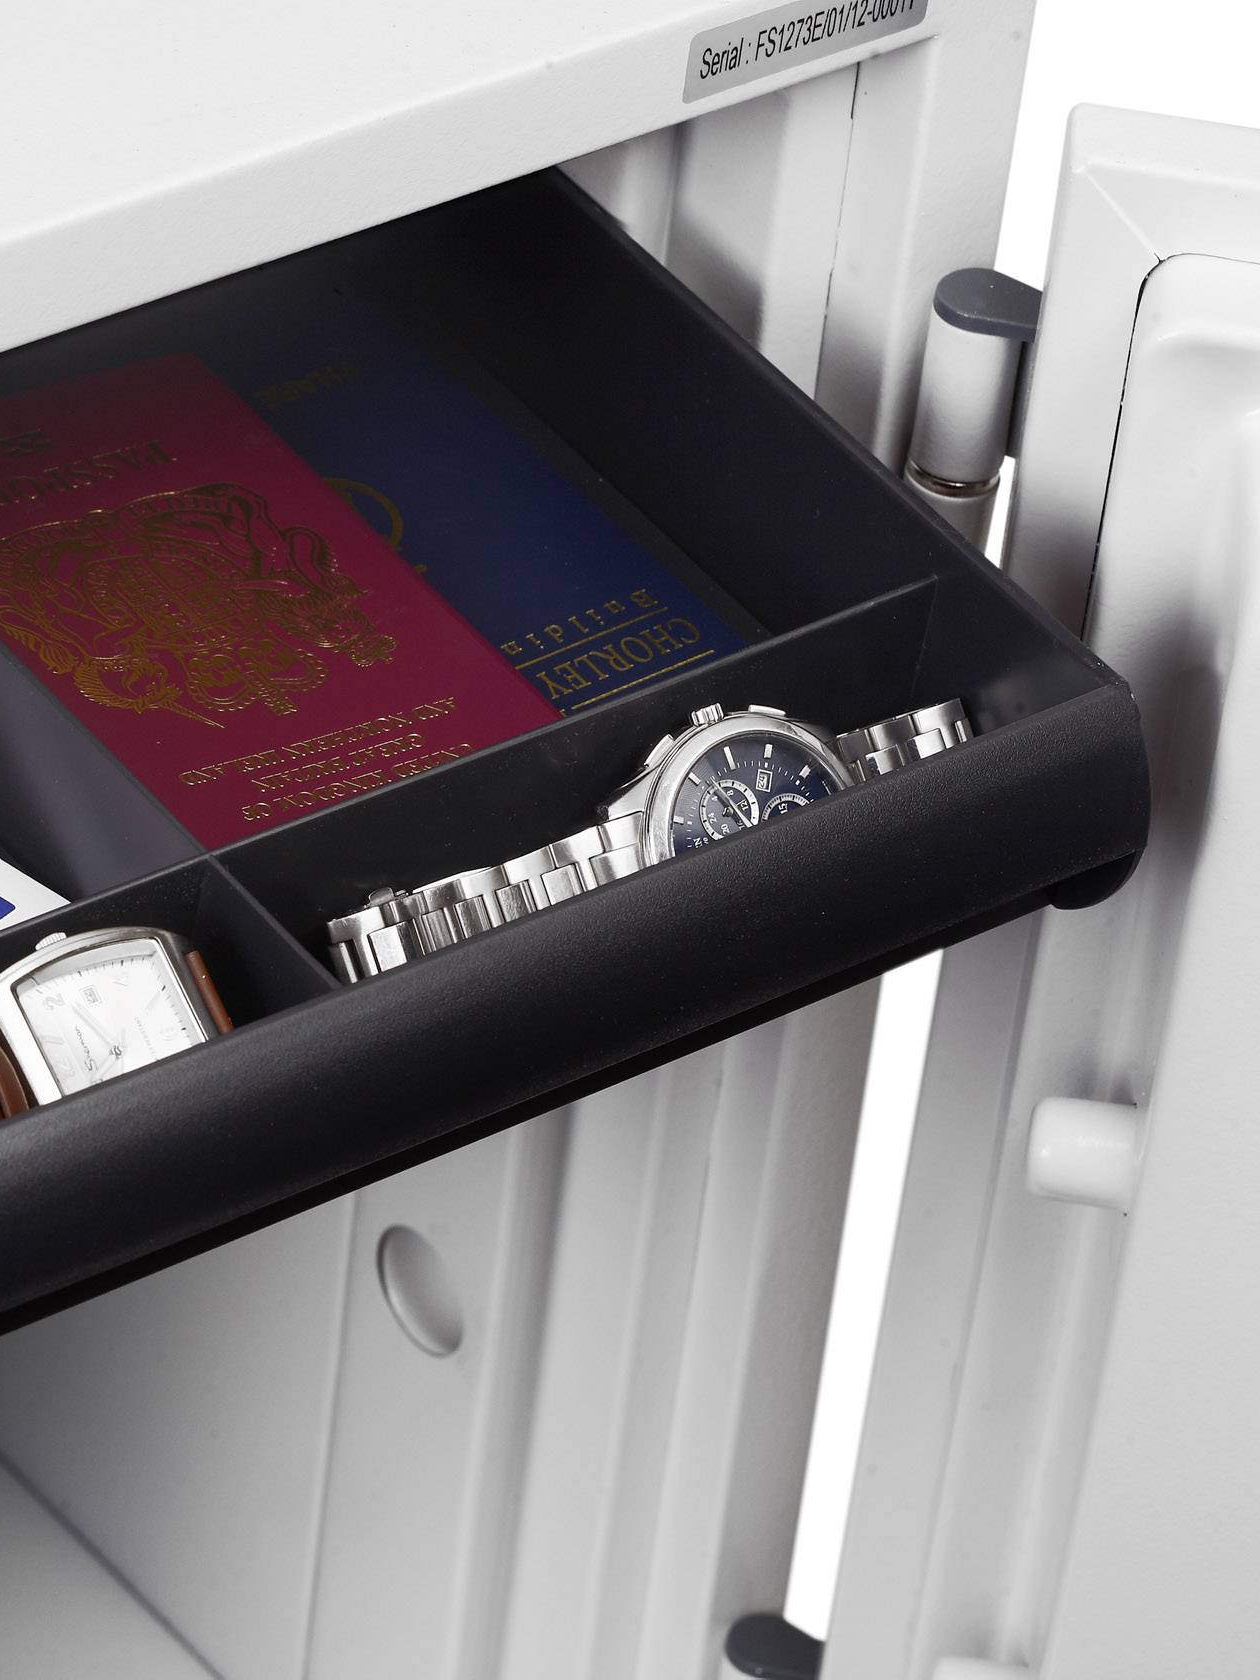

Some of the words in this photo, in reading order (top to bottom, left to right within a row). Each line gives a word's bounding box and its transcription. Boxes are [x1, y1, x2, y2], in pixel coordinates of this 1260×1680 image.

[699, 37, 744, 80] Serial
[536, 617, 701, 700] CHORLEY
[411, 696, 457, 721] AND
[281, 711, 413, 761] NORTHERN
[347, 733, 423, 767] GREAT
[178, 748, 285, 787] IRELAND
[251, 755, 349, 792] BRITAIN
[273, 768, 392, 813] KINGDOM
[778, 802, 788, 815] 15
[241, 802, 272, 822] OF
